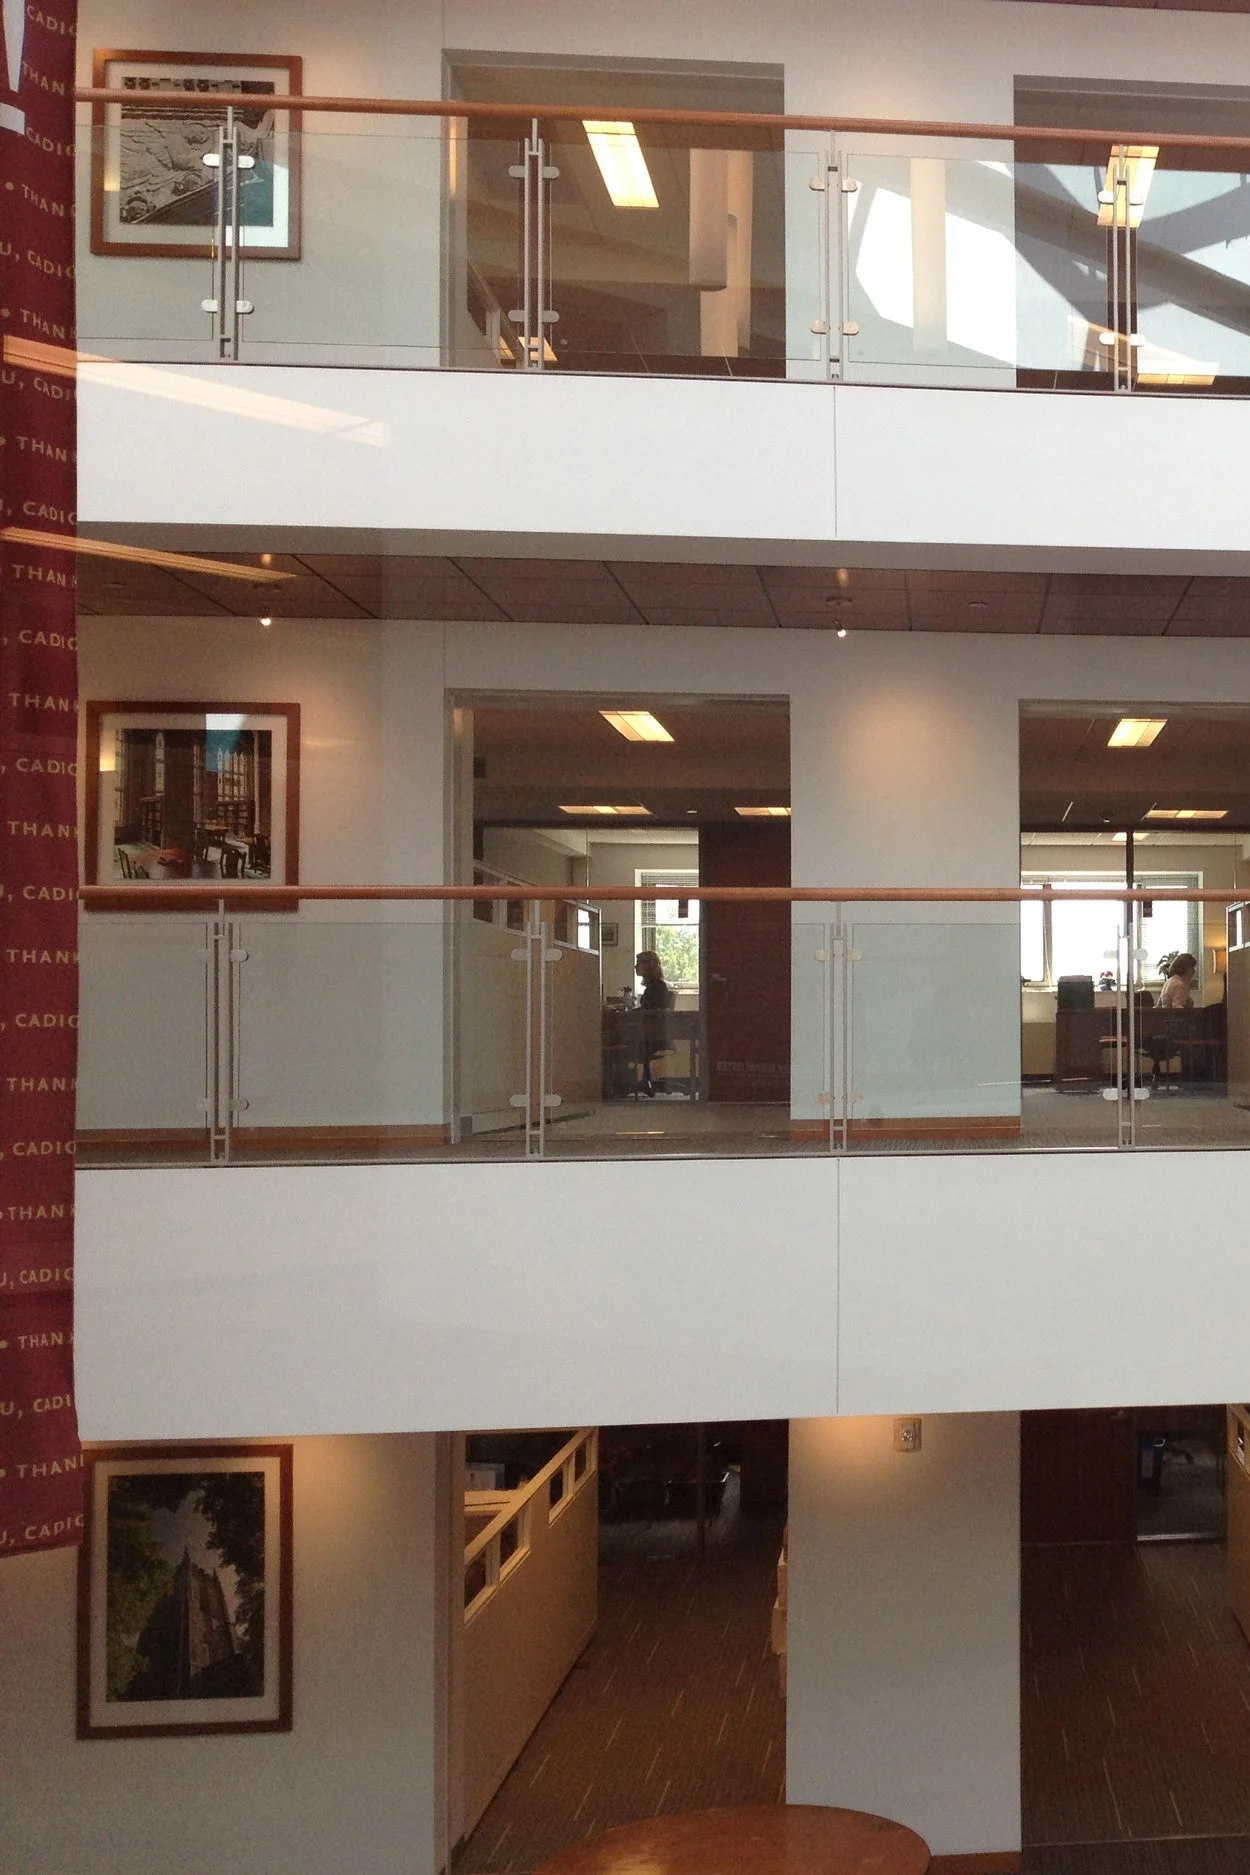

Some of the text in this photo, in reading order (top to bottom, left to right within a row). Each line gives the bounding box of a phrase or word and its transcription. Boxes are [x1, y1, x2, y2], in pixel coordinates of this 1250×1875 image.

[22, 61, 76, 96] THAN
[21, 183, 76, 217] THAN
[20, 308, 76, 340] THAN
[34, 377, 77, 401] CADI
[17, 436, 77, 463] THAN
[23, 885, 79, 901] CADI
[8, 1204, 75, 1220] THAN
[18, 1331, 74, 1349] THAN
